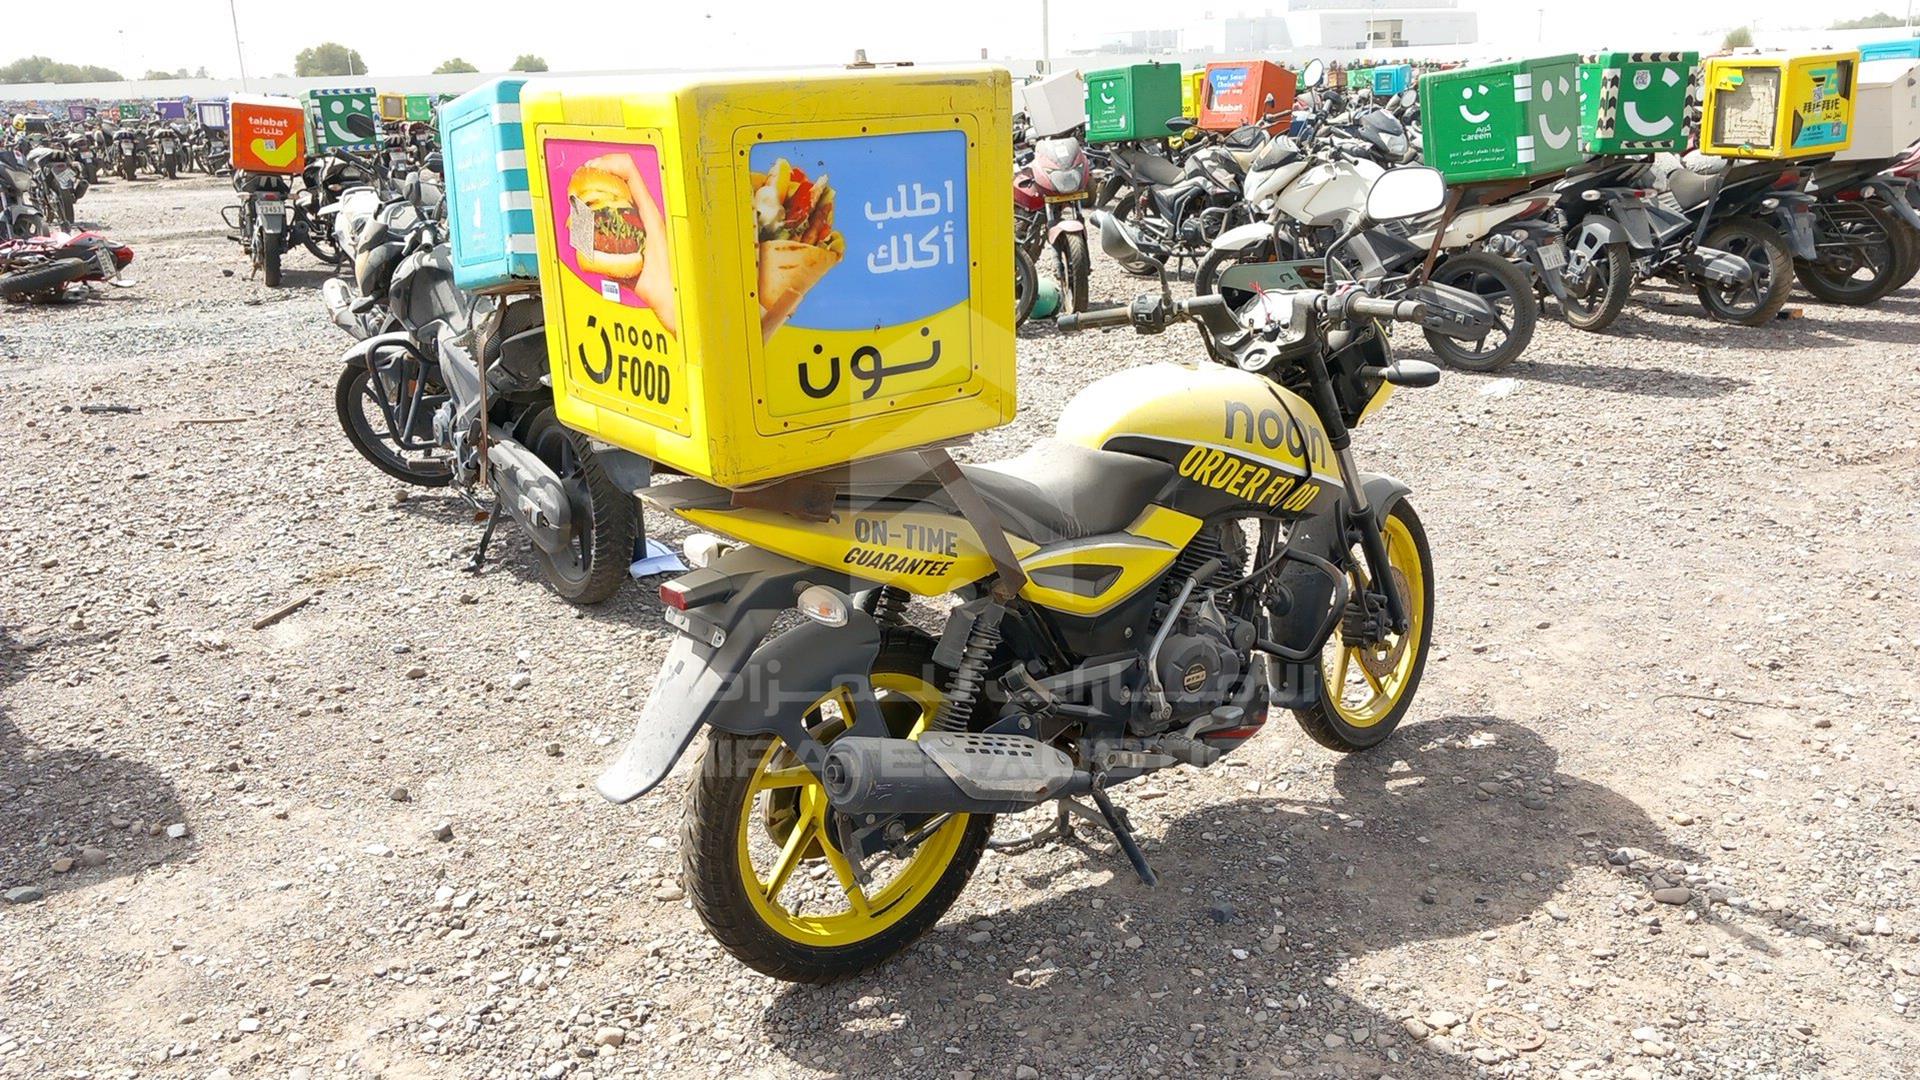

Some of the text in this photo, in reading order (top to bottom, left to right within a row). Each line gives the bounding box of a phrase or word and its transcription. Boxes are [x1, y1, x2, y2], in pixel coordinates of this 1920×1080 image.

[248, 116, 288, 128] talabat
[1461, 132, 1492, 142] Careem
[864, 179, 954, 229] اطلب
[867, 219, 954, 274] أكلك
[614, 322, 667, 355] noon
[797, 326, 942, 400] نون
[618, 354, 670, 405] FOOD
[1225, 399, 1326, 469] noon
[1178, 445, 1271, 502] ORDER
[843, 547, 955, 577] GUARANTEE
[854, 518, 958, 558] ON-TIME
